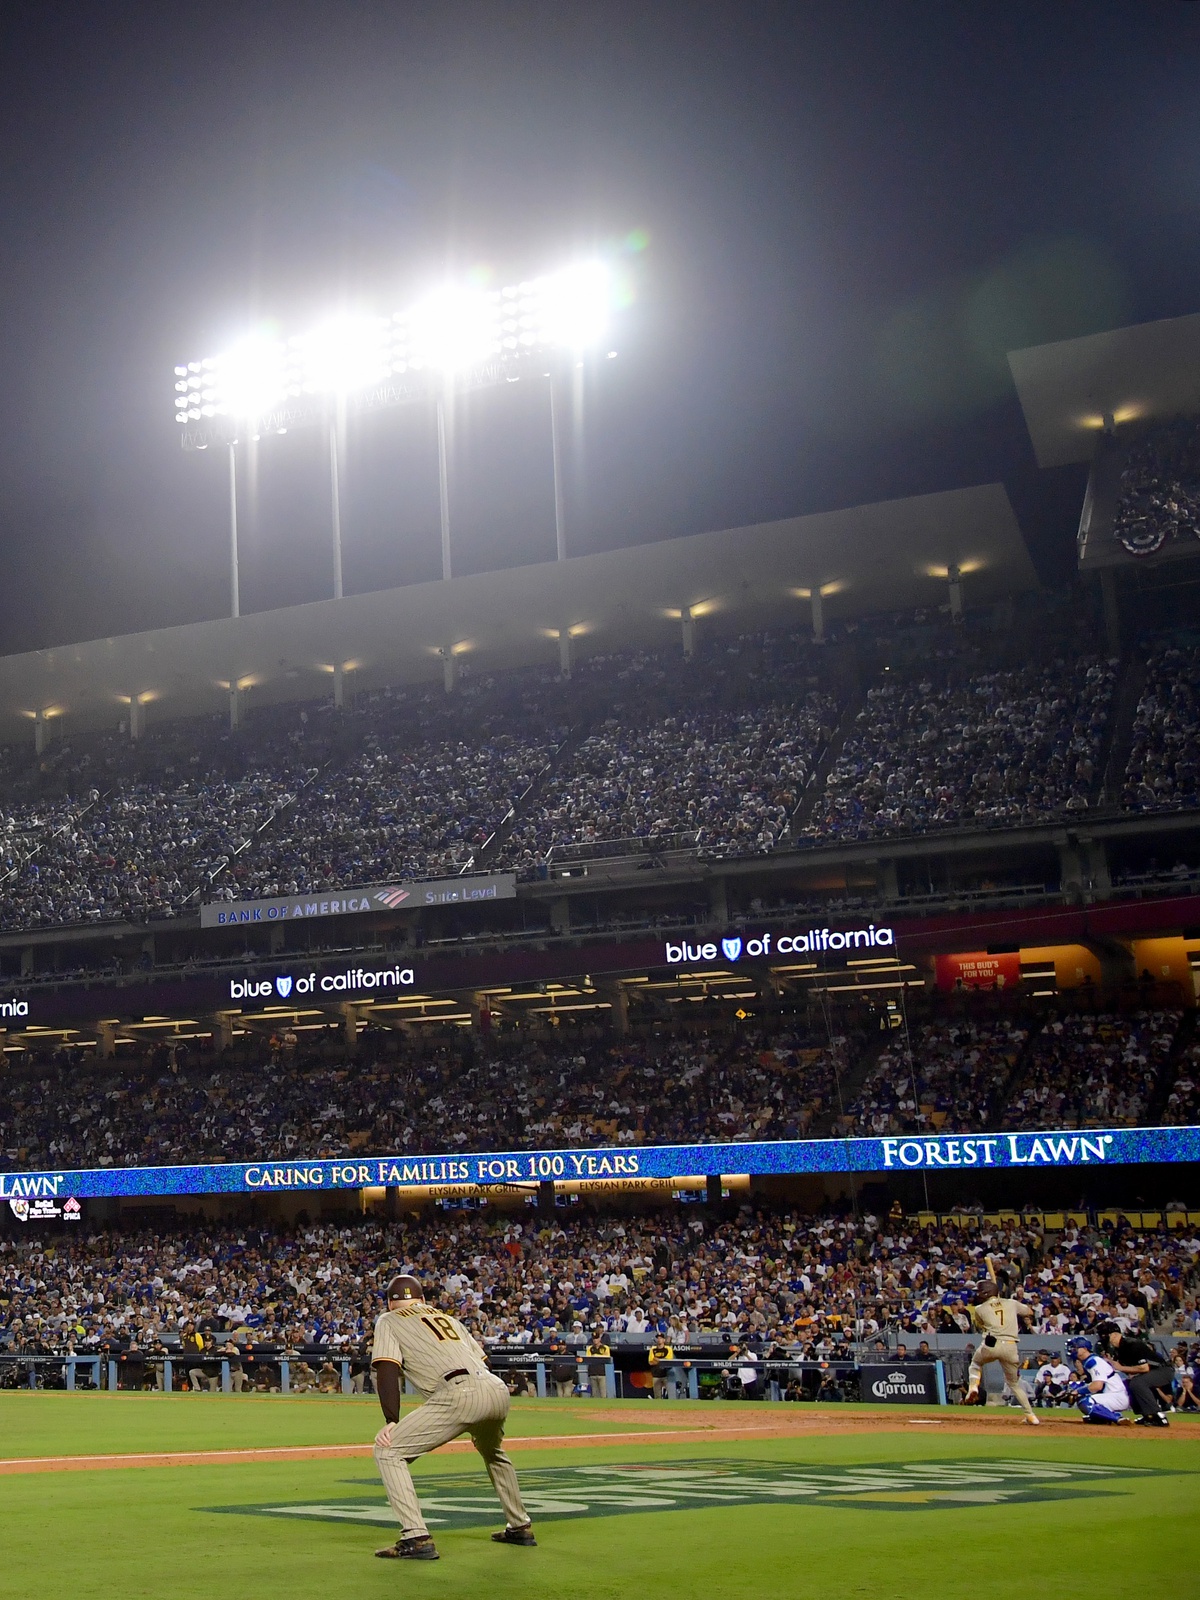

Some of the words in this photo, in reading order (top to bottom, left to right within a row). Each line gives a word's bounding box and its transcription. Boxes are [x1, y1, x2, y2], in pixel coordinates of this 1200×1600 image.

[218, 909, 262, 924] BANK
[267, 906, 288, 919] OF
[293, 897, 371, 917] AMERICA
[425, 891, 459, 904] Suite
[462, 885, 497, 900] Level
[666, 941, 718, 963] blue
[746, 933, 771, 957] of
[776, 924, 893, 954] california
[976, 961, 999, 969] BUD'S
[230, 980, 273, 999] blue
[295, 973, 316, 994] of
[320, 965, 414, 992] california
[881, 1139, 997, 1167] FOREST
[245, 1167, 323, 1187] CARING
[331, 1165, 373, 1184] FOR
[379, 1161, 469, 1181] FAMILIES
[478, 1160, 521, 1179] FOR
[528, 1156, 564, 1176] 100
[570, 1154, 639, 1175] YEARS
[428, 1186, 467, 1196] ELYSIAN
[468, 1185, 491, 1194] PARK
[494, 1184, 520, 1194] GRILL
[580, 1181, 620, 1191] ELYSIAN
[622, 1180, 647, 1190] PARK
[650, 1179, 678, 1189] GRILL
[421, 1317, 461, 1341] 18
[994, 1309, 1004, 1326] 7
[871, 1380, 926, 1399] Corona
[261, 1459, 1155, 1523] POSTSEASON
